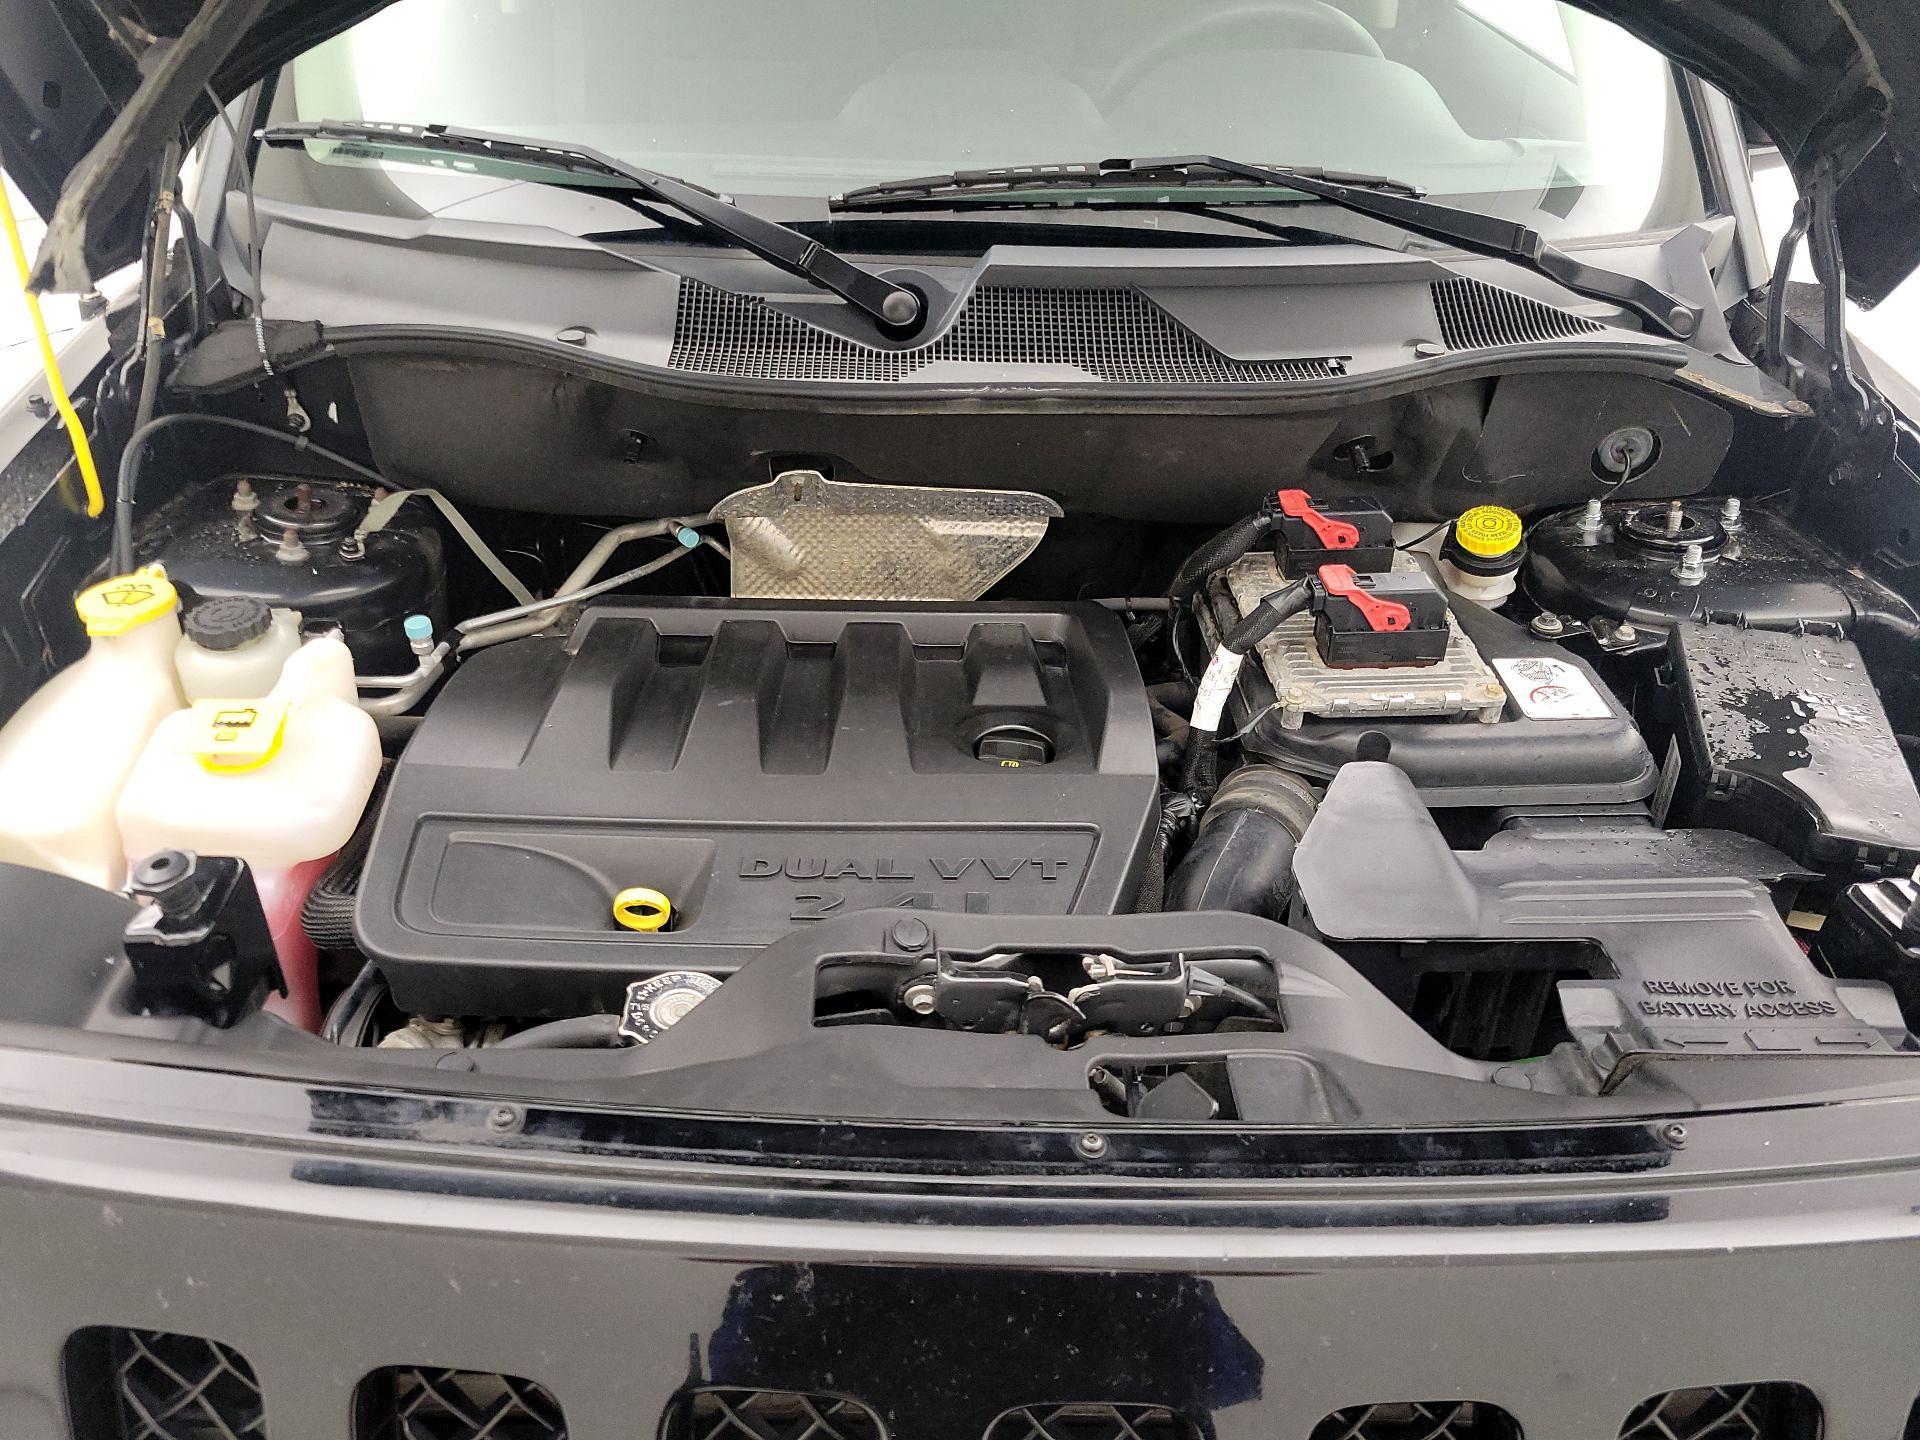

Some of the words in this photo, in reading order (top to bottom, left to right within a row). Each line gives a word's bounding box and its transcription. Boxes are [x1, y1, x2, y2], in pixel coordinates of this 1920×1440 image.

[739, 857, 915, 881] DUAL
[929, 857, 1068, 881] VVT
[1641, 980, 1743, 998] REMOVE
[1742, 980, 1797, 997] FOR
[1639, 1000, 1738, 1018] BATTERY
[1743, 1000, 1838, 1018] ACCESS
